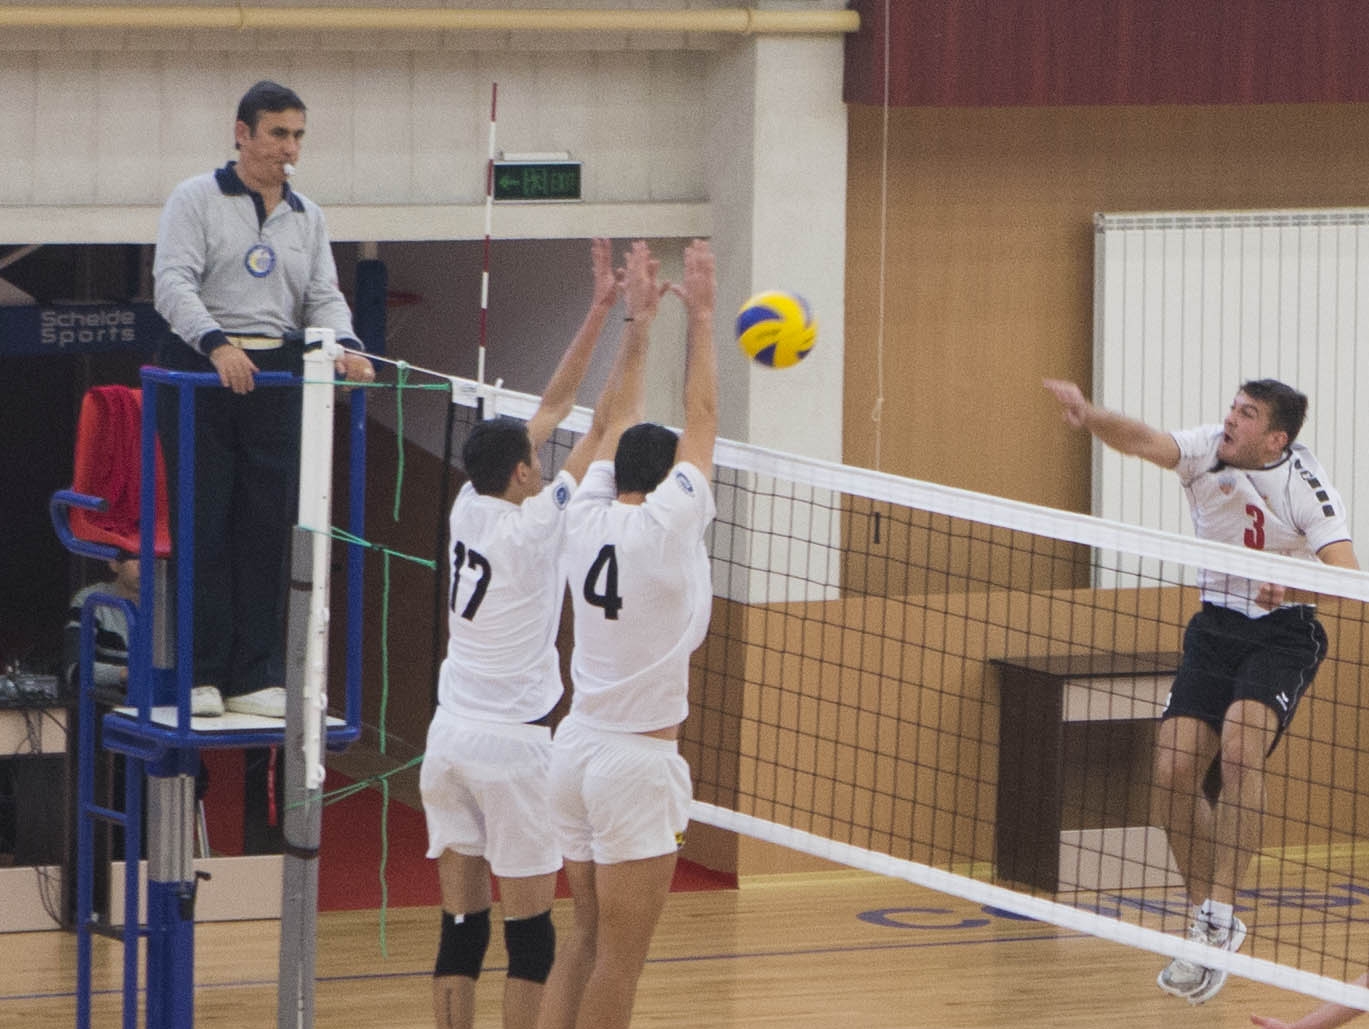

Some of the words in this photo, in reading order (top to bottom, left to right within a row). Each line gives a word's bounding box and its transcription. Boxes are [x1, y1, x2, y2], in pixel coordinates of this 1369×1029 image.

[41, 327, 136, 348] Sports
[1244, 503, 1265, 550] 3
[451, 540, 492, 621] 17
[583, 544, 623, 620] 4
